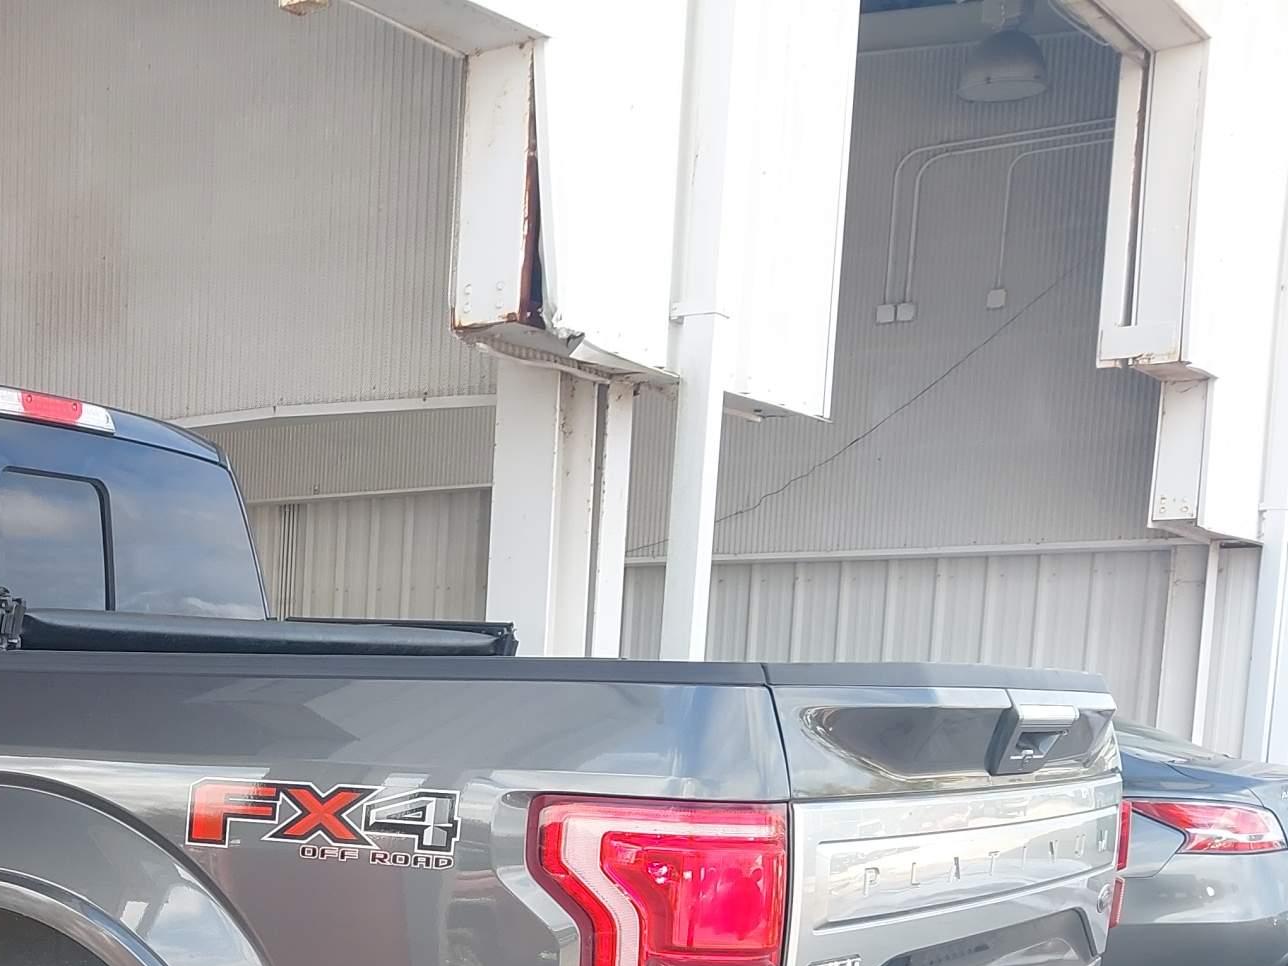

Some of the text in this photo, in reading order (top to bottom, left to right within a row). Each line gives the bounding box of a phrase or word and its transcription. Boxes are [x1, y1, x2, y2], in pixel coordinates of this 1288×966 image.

[185, 776, 461, 855] FX4
[300, 845, 454, 870] OFF ROAD
[862, 829, 1109, 897] PLATINUM
